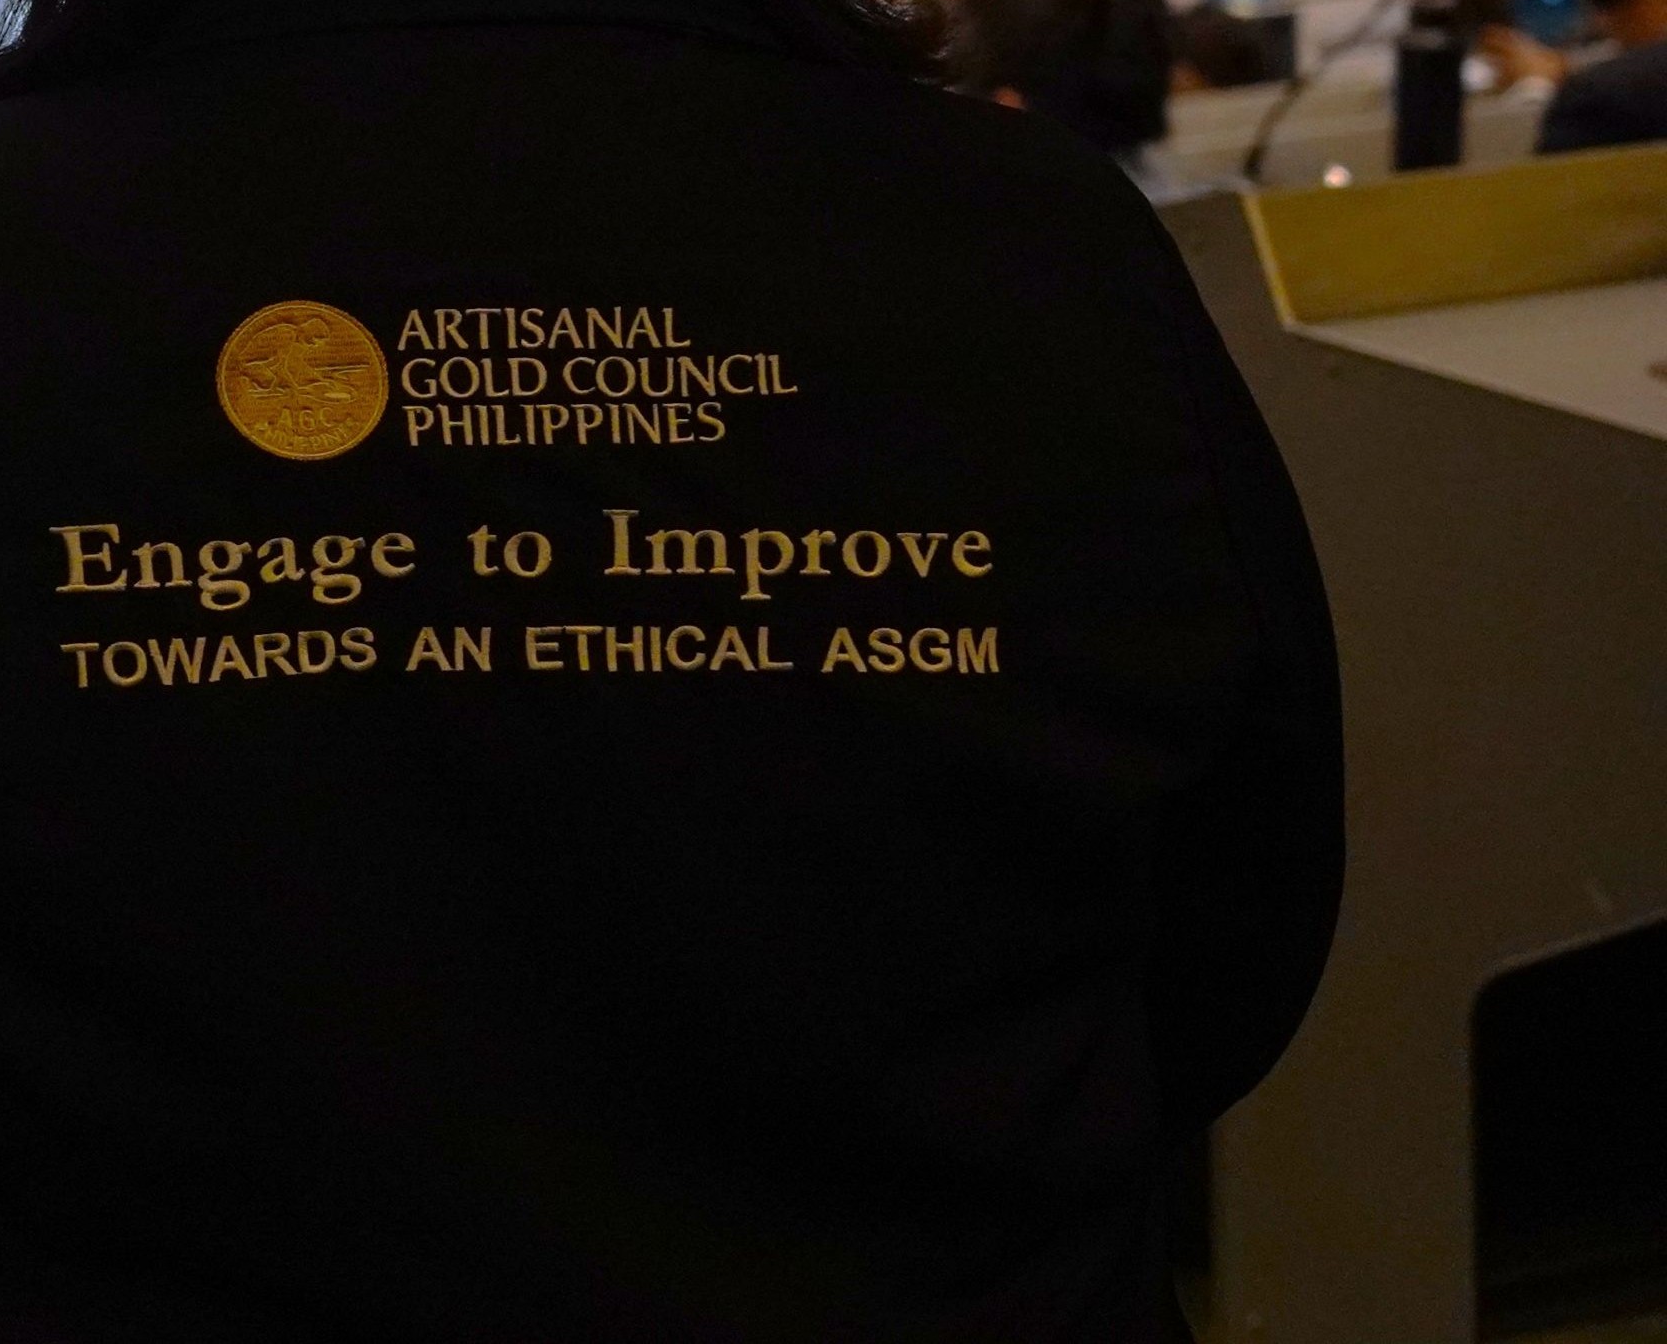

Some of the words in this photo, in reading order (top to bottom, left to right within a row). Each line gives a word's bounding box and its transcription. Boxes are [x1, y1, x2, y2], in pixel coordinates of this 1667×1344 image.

[397, 306, 691, 351] ARTISANAL
[401, 356, 548, 399] GOLD
[562, 353, 798, 398] COUNCIL
[402, 401, 726, 447] PHILIPPINES
[49, 523, 415, 611] Engage
[467, 524, 552, 578] to
[602, 509, 993, 600] Improve
[60, 626, 377, 688] TOWARDS
[405, 626, 492, 672] AN
[525, 625, 793, 672] ETHICAL
[821, 627, 1000, 674] ASGM
